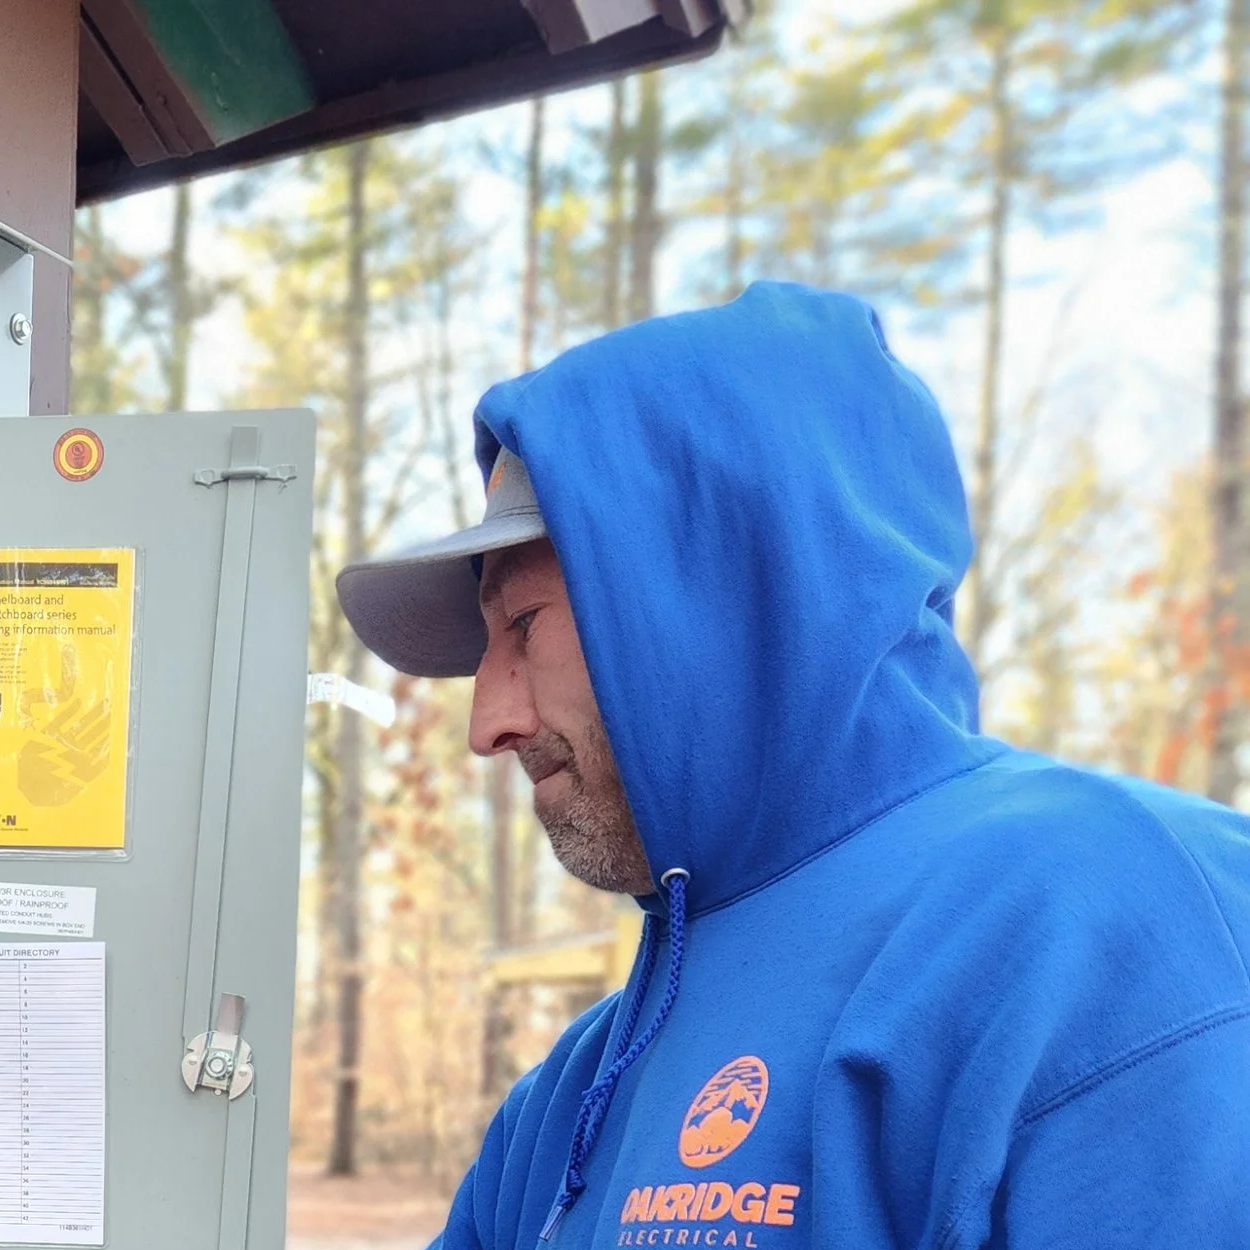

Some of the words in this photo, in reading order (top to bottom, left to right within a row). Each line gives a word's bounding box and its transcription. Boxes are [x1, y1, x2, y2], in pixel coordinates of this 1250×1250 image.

[44, 594, 64, 606] and
[46, 610, 77, 621] series
[13, 624, 75, 636] information
[77, 624, 116, 636] manual
[14, 888, 66, 898] ENCLOSURE
[20, 899, 69, 910] RAINPROOF
[14, 949, 60, 957] DIRECTORY
[620, 1181, 800, 1226] OAKRIDGE
[618, 1228, 758, 1249] ELECTRICAL
